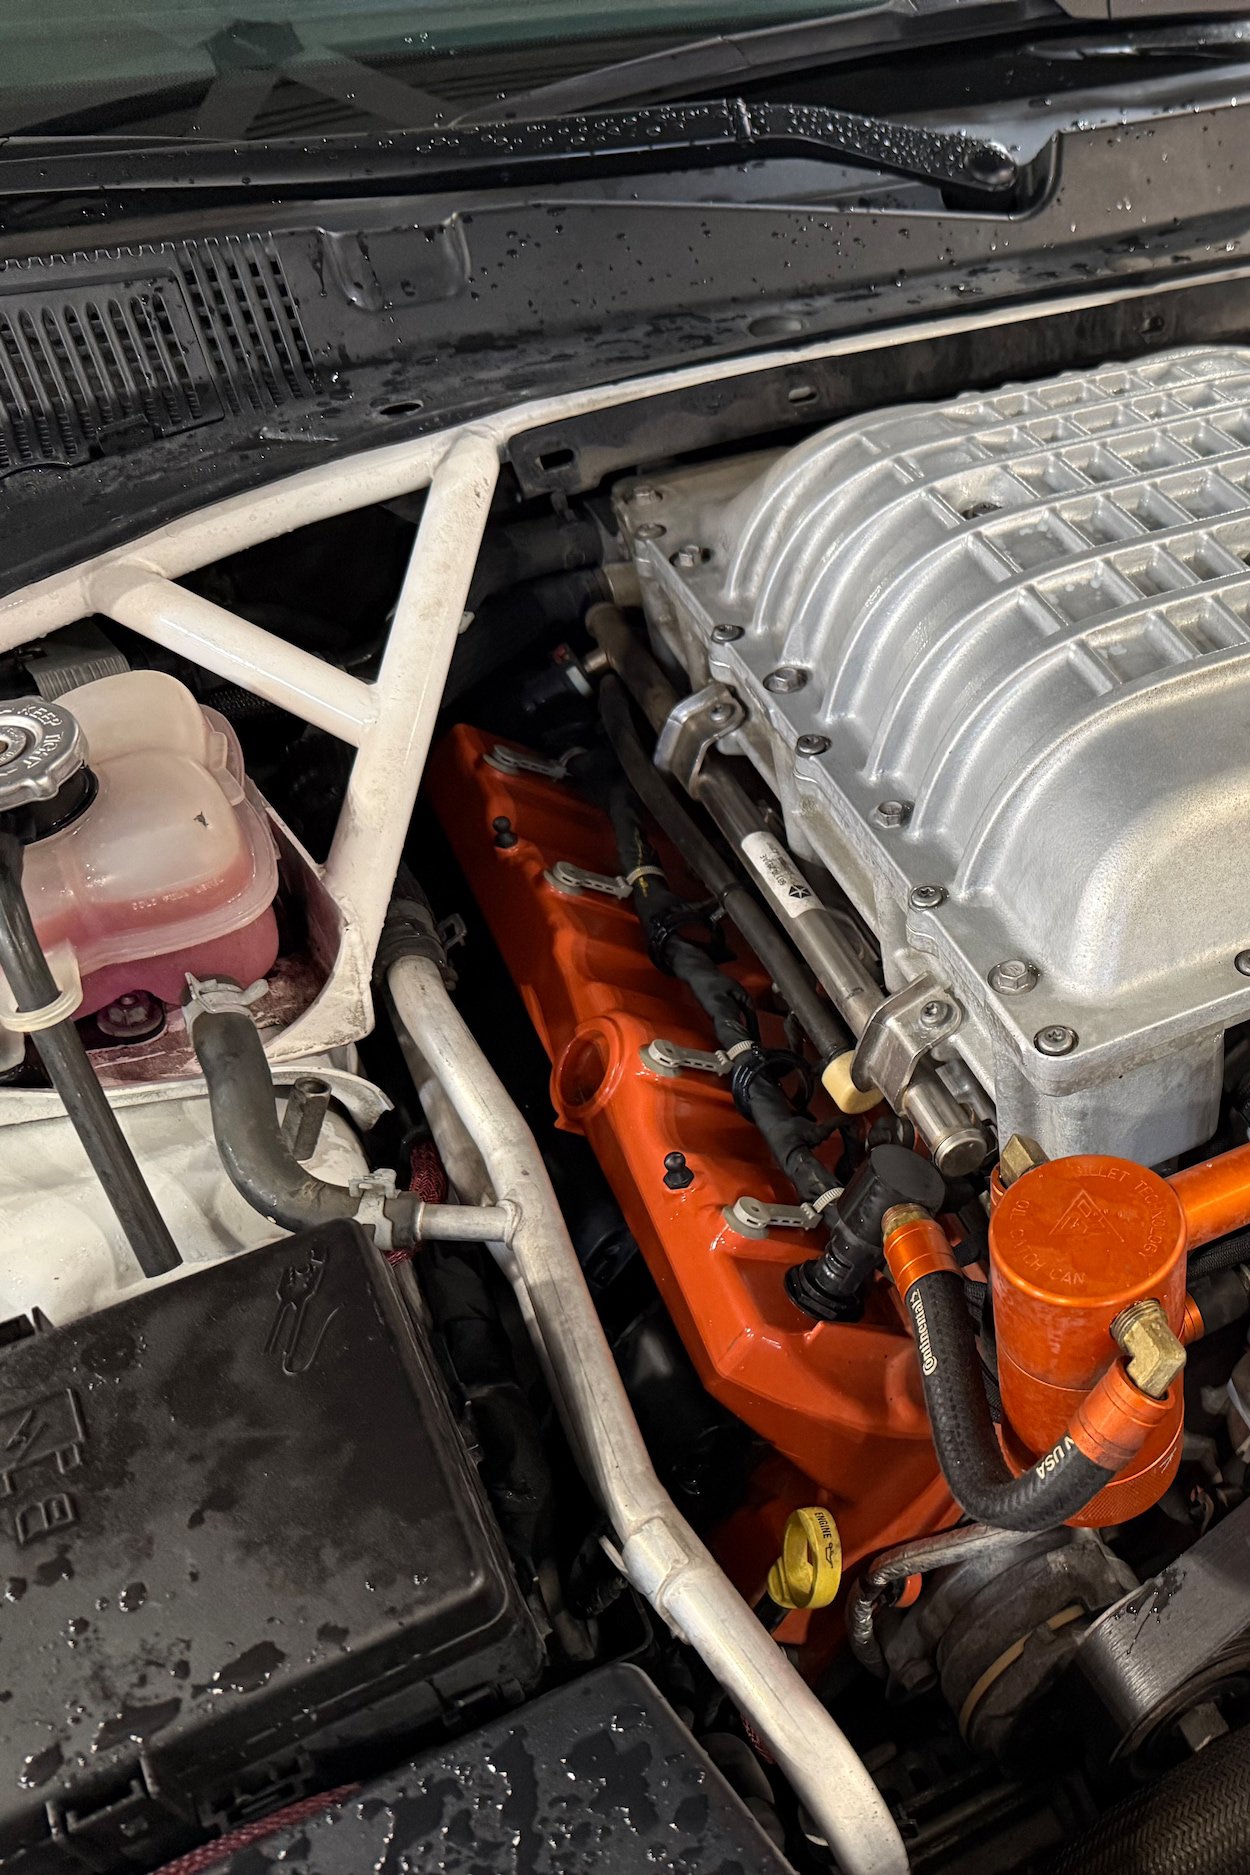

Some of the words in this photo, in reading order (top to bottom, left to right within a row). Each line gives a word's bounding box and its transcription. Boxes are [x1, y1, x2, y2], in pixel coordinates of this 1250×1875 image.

[17, 704, 63, 727] KEEP
[1050, 1267, 1086, 1286] CAN
[909, 1288, 938, 1376] Continental
[1035, 1445, 1066, 1480] USA
[814, 1511, 832, 1539] ENGINE
